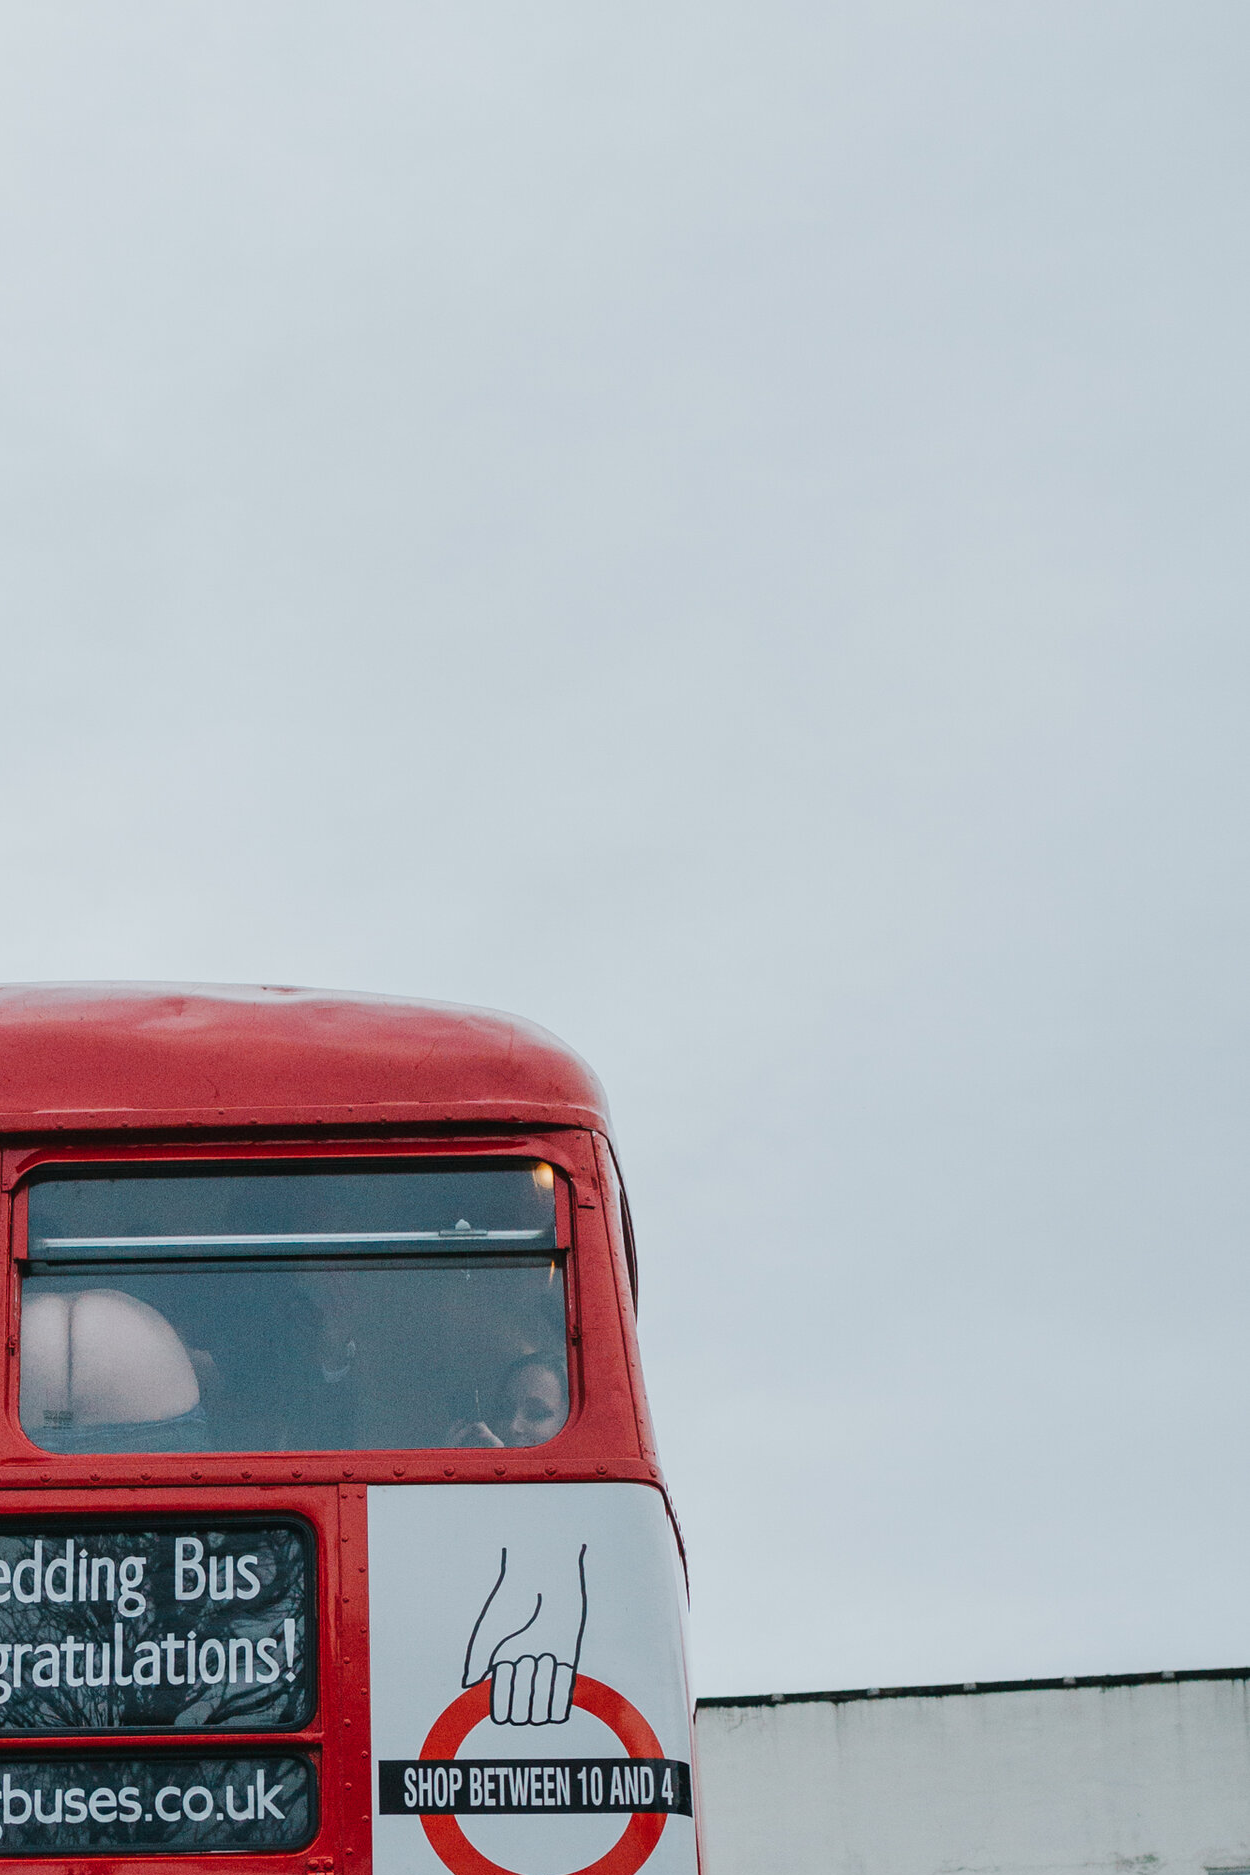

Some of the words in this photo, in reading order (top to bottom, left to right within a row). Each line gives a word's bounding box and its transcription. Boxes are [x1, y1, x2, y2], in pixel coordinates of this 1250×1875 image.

[175, 1536, 261, 1601] Bus
[404, 1766, 463, 1808] SHOP
[469, 1766, 571, 1807] BETWEEN
[578, 1766, 604, 1806] 10
[610, 1766, 655, 1806] AND
[661, 1766, 674, 1806] 4
